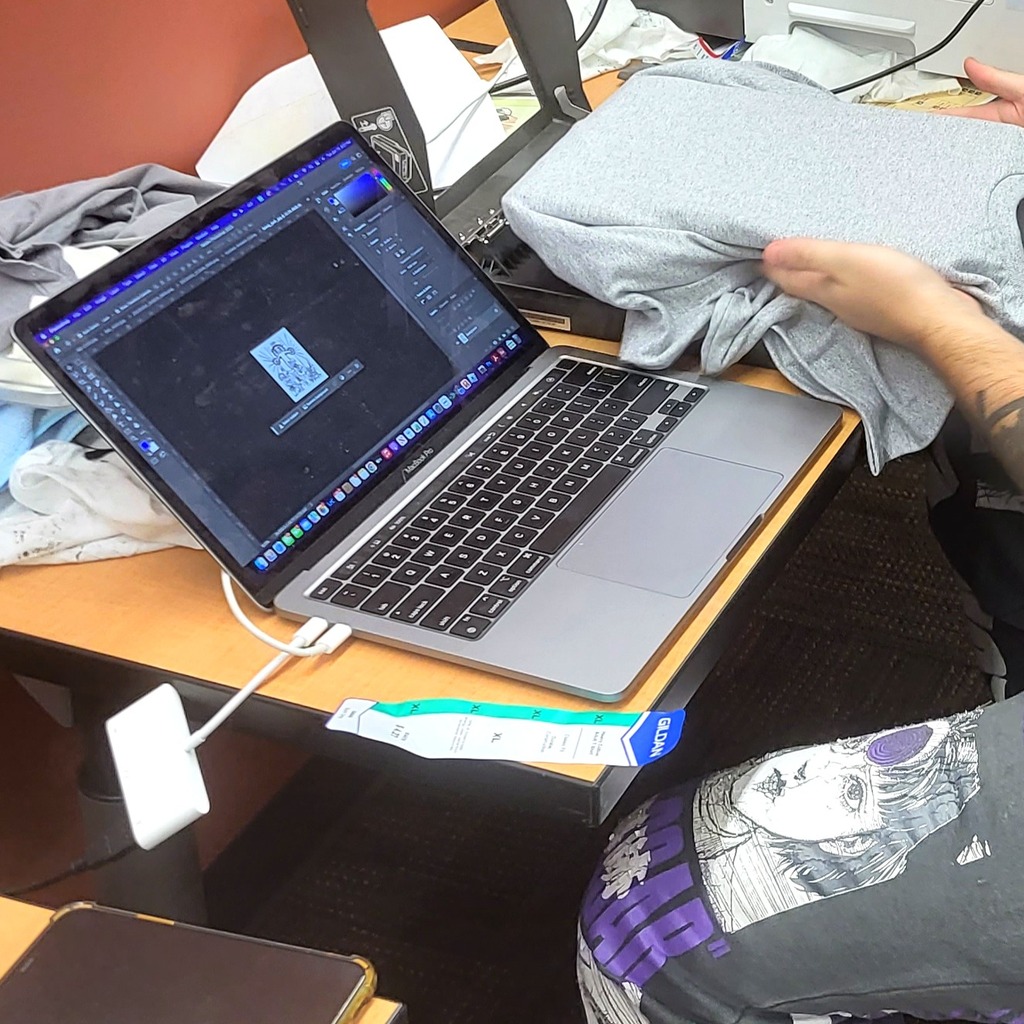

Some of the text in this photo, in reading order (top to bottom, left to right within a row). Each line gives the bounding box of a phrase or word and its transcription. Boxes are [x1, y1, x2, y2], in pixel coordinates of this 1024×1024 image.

[404, 447, 434, 474] MacBook Pro
[411, 703, 421, 715] XL
[470, 704, 480, 714] XL
[531, 709, 541, 720] XL
[593, 714, 604, 724] XL
[491, 732, 503, 743] XL
[648, 717, 671, 758] GILDAN
